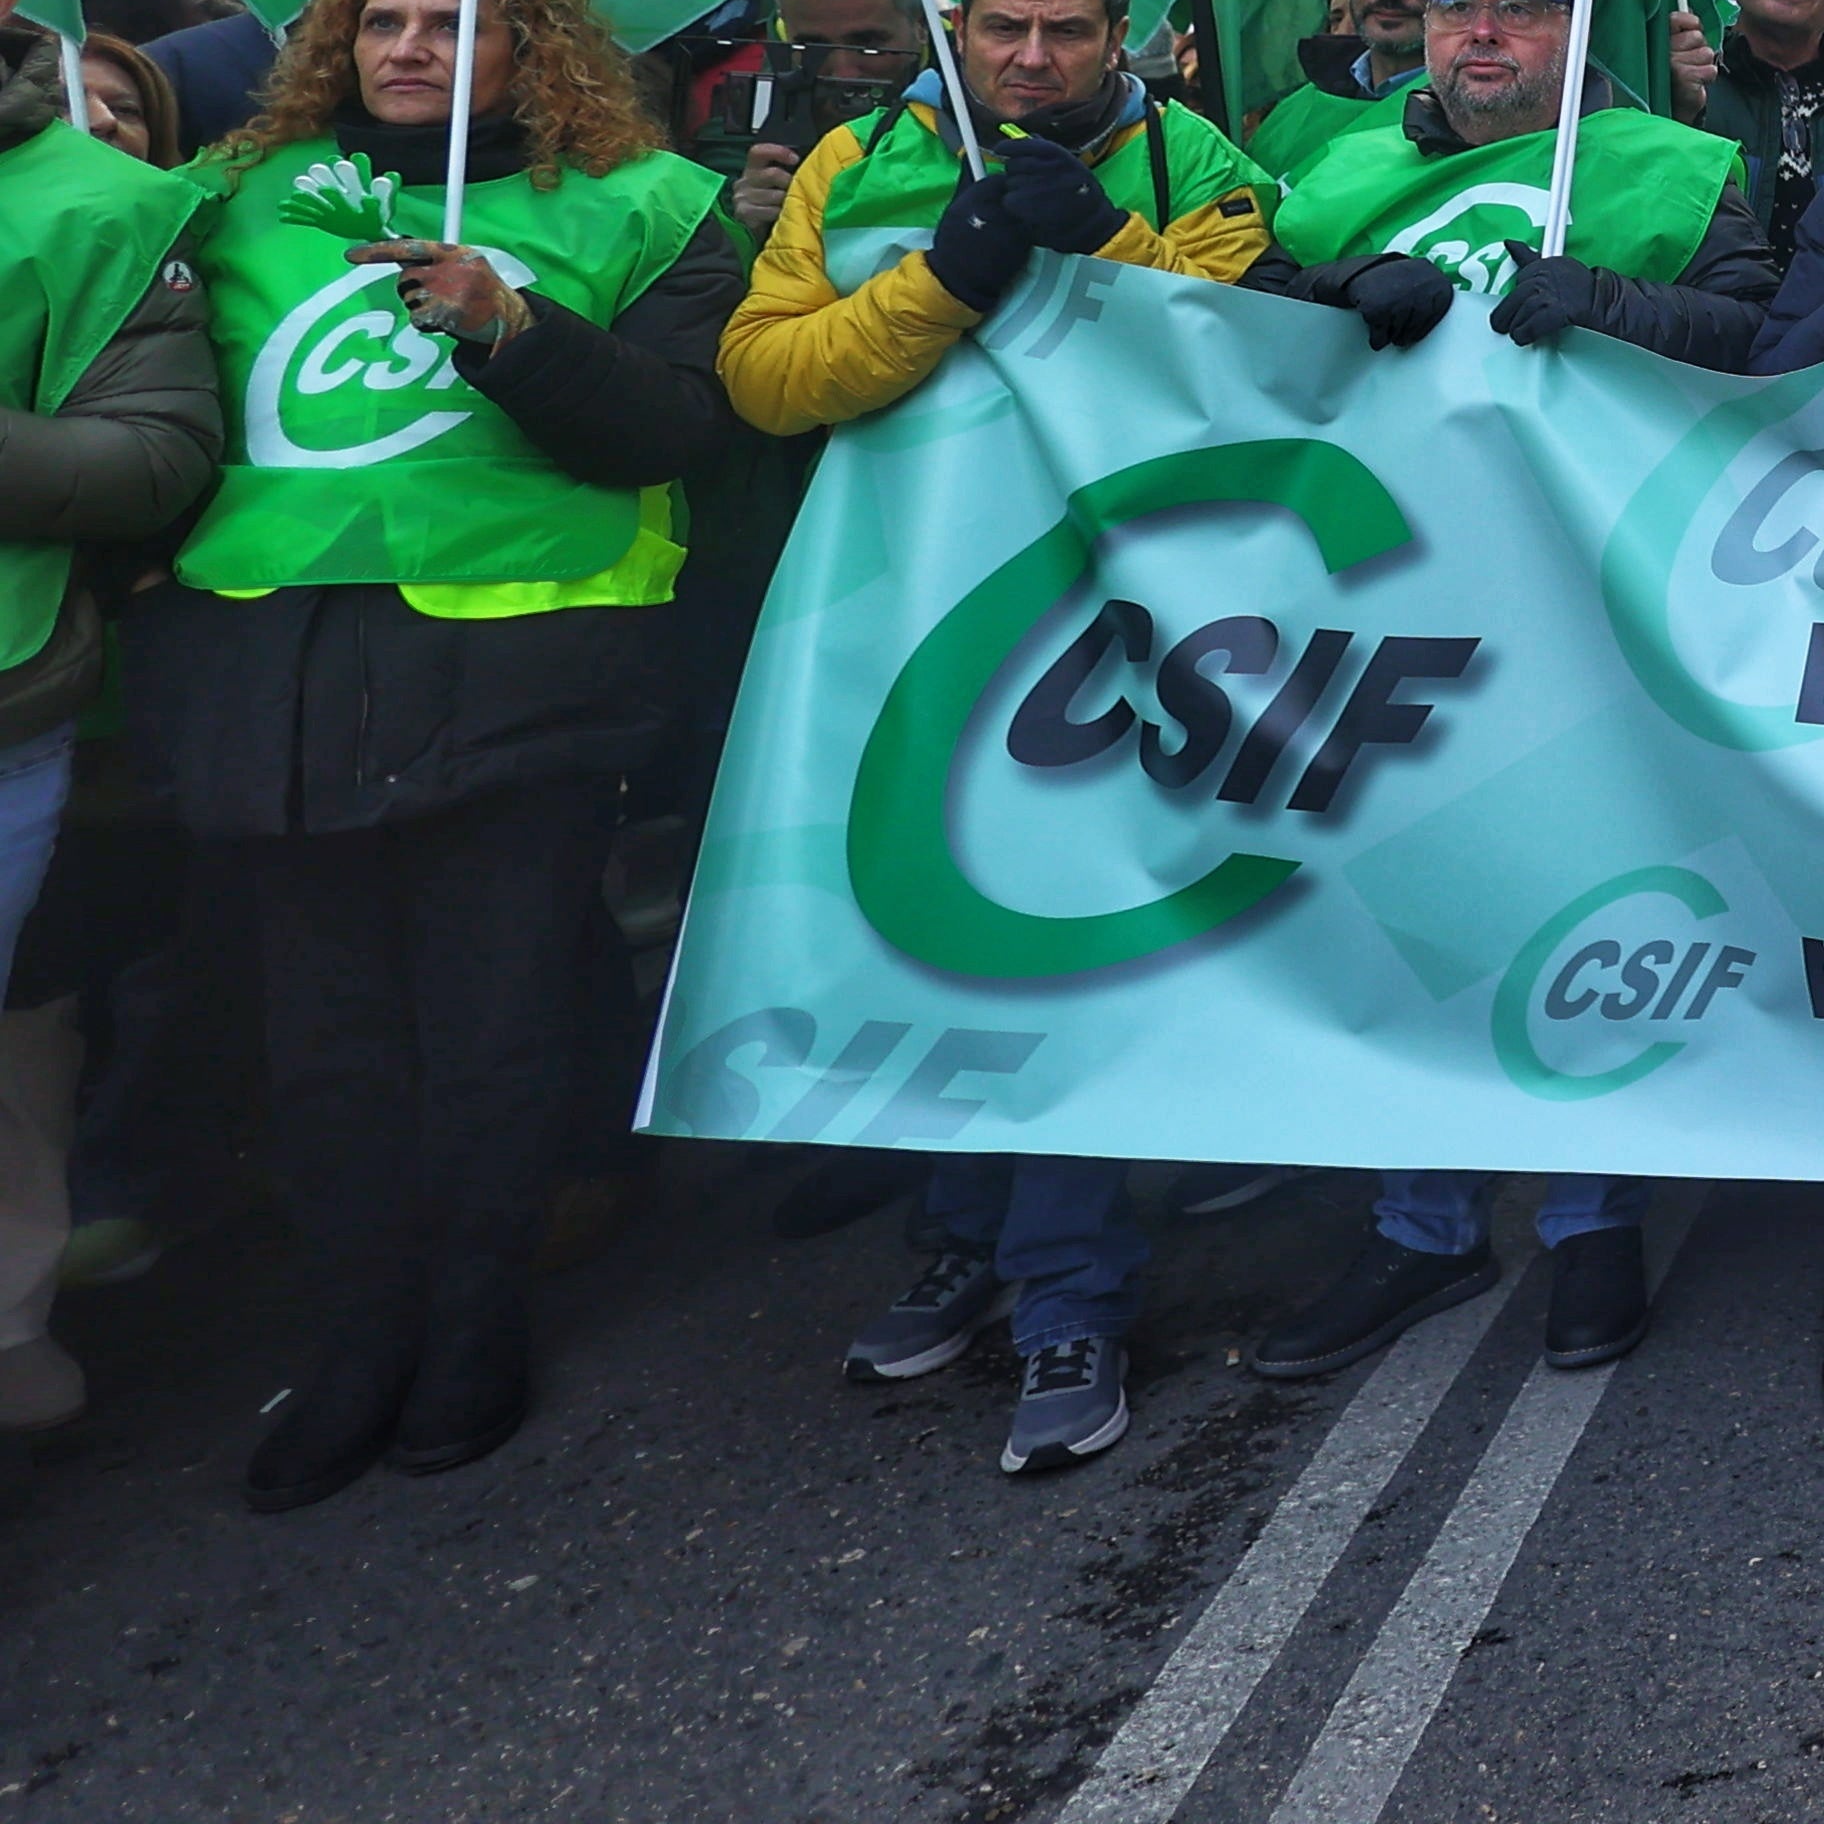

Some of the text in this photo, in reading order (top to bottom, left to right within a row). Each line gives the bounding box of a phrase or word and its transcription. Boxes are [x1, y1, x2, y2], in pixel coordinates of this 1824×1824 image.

[1005, 597, 1482, 813] CSIF
[1543, 938, 1758, 1022] CSIF
[655, 1006, 1048, 1144] SIF
